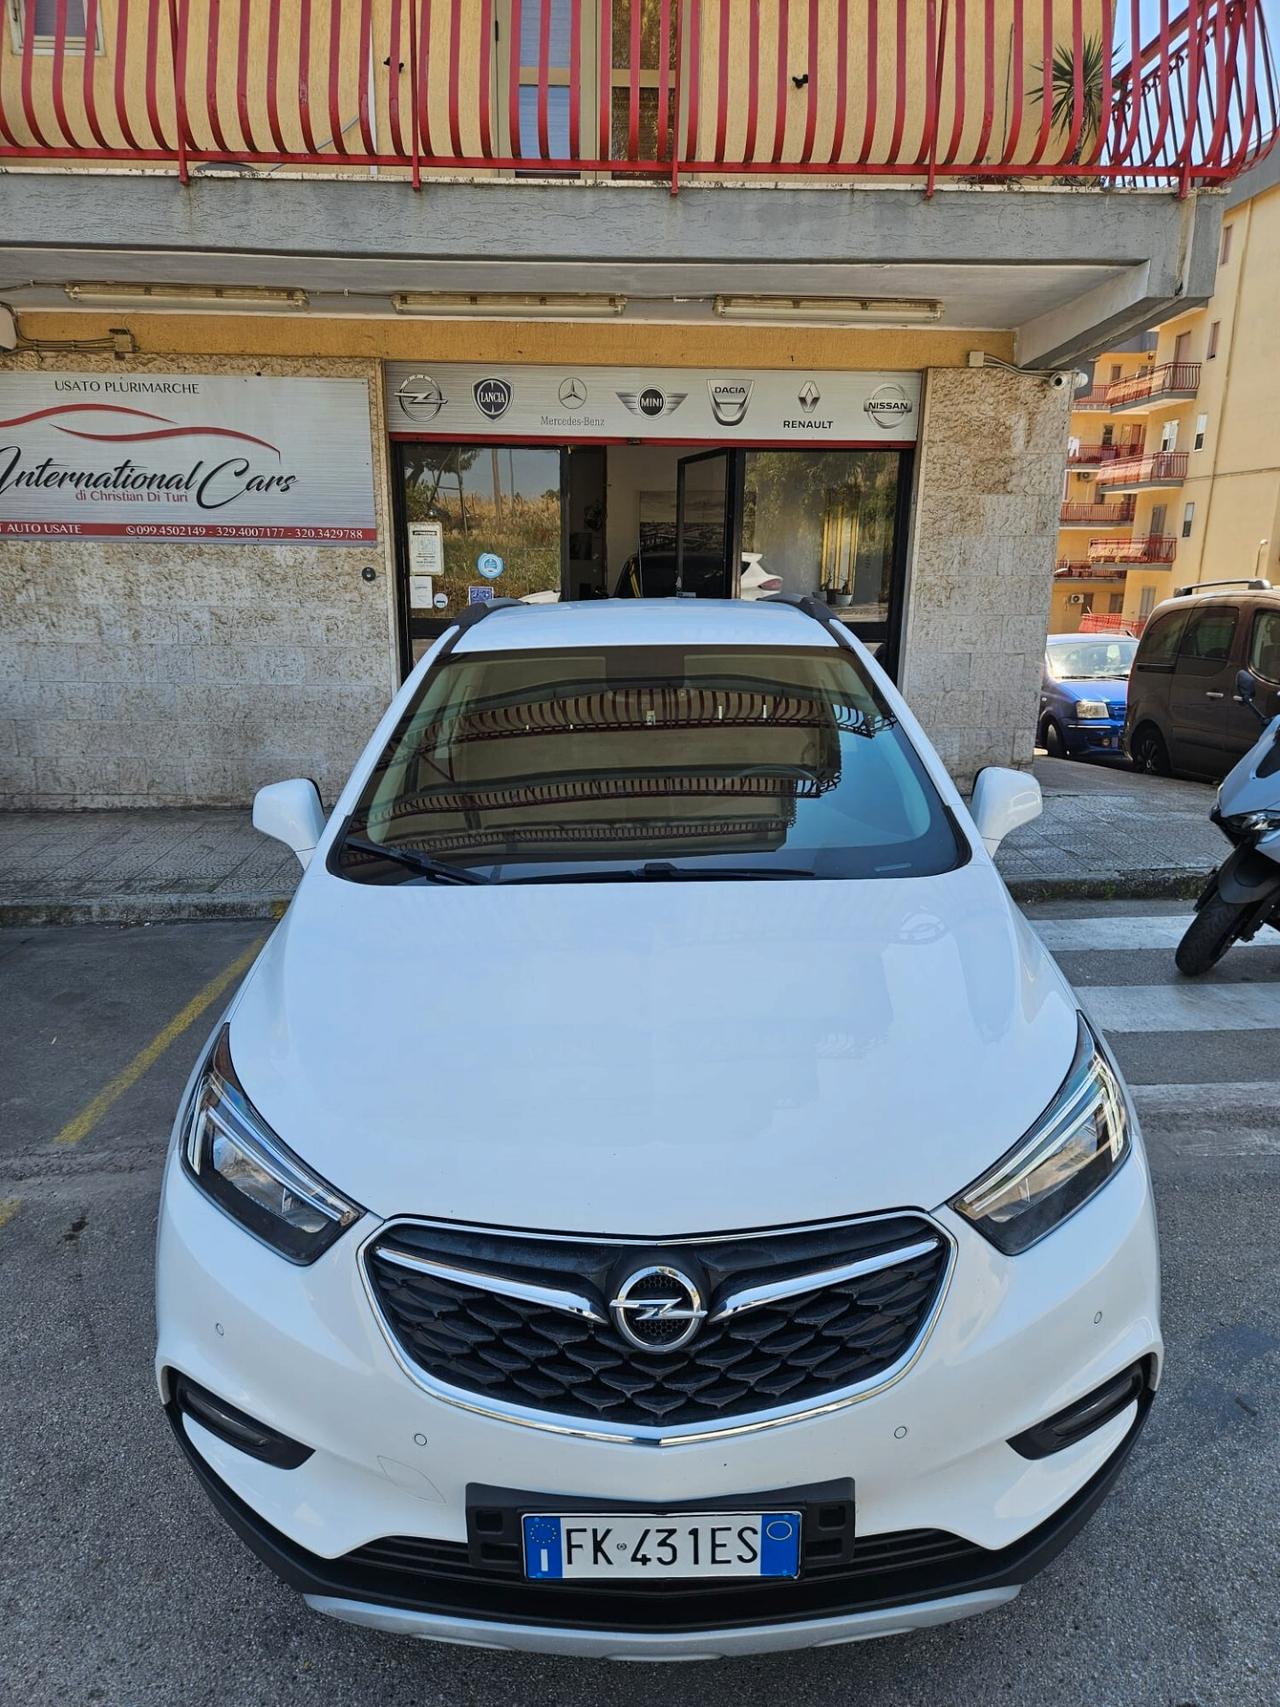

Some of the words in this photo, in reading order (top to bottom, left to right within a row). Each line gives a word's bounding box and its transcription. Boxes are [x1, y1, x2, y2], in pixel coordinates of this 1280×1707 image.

[54, 380, 101, 392] USATO
[104, 381, 200, 394] PLURIMARCHE
[714, 386, 746, 395] DACIA
[480, 392, 506, 403] LANCIA
[640, 397, 663, 407] MINI
[868, 401, 909, 411] NISSAN
[540, 415, 605, 427] Mercedes-Benz
[783, 420, 834, 429] RENAULT
[196, 458, 298, 509] Cars
[75, 490, 86, 501] di
[90, 490, 143, 501] Christian
[147, 491, 161, 502] Di
[164, 491, 188, 502] Turi
[7, 523, 41, 533] AUTO
[44, 523, 82, 534] USATE
[136, 525, 206, 536] 099.4502149
[216, 526, 285, 537] 329.4007177
[295, 528, 363, 539] 320.3429788
[565, 1528, 614, 1565] FK
[630, 1526, 759, 1566] 431ES
